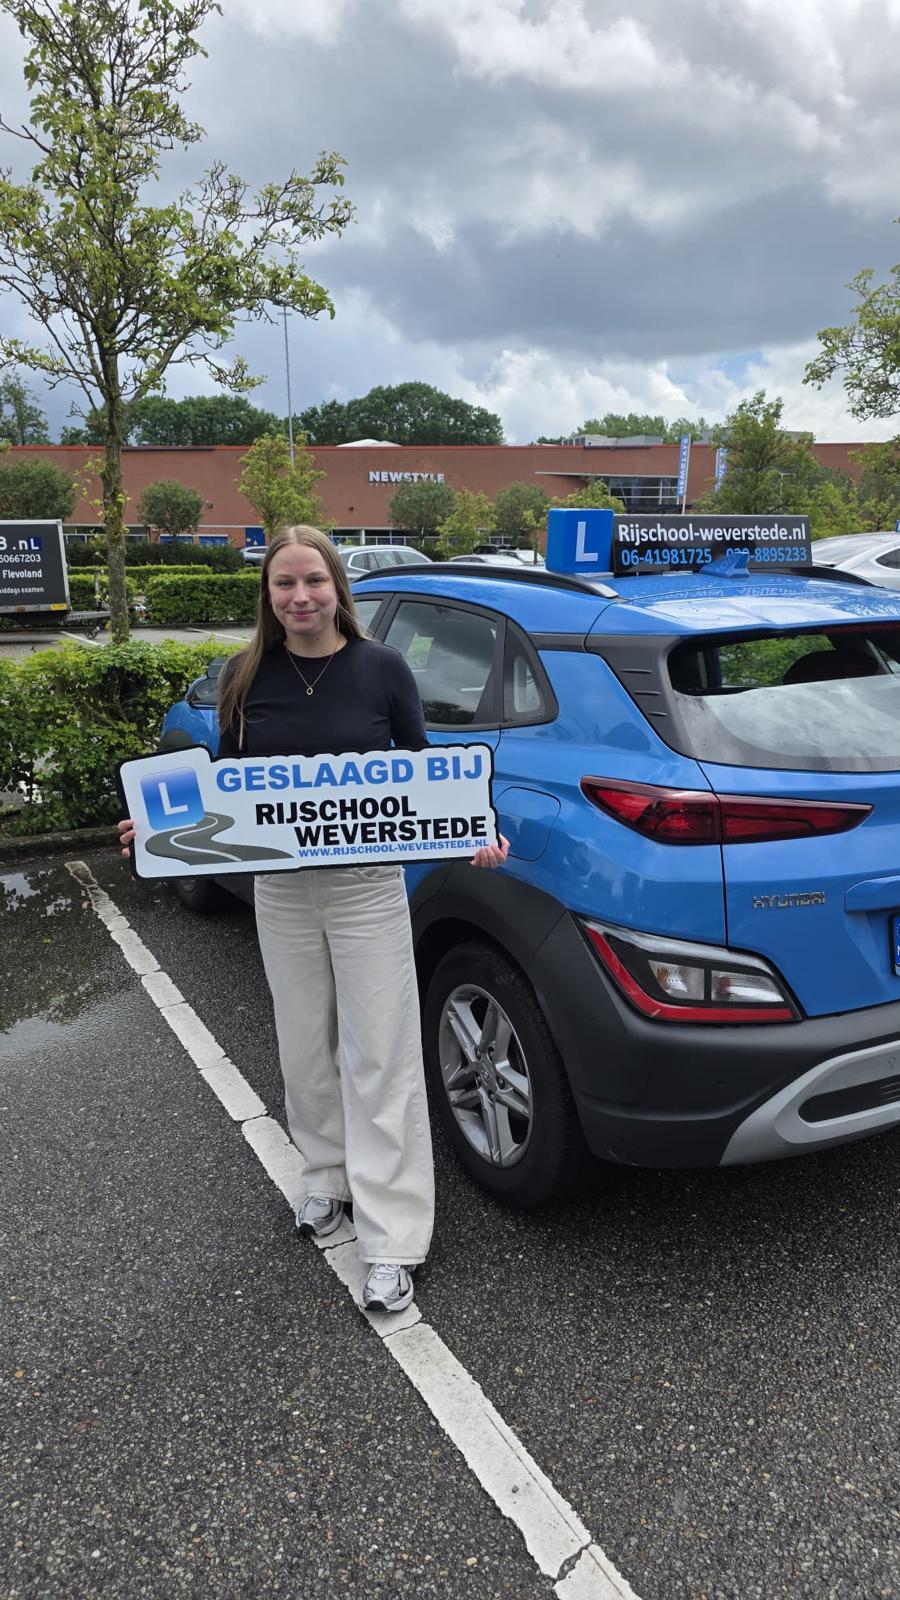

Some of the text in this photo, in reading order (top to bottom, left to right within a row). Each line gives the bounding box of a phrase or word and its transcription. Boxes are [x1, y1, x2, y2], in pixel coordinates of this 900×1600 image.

[369, 471, 445, 485] NEWSTYLE
[575, 521, 599, 563] L
[618, 523, 806, 546] Rijschool-weverstede.nl
[621, 548, 712, 567] 06-41981725
[2, 569, 42, 579] Flevoland
[215, 754, 483, 793] GESLAAGD BIJ
[157, 782, 189, 817] L
[255, 795, 417, 826] RIJSCHOOL
[293, 815, 487, 848] WEVERSTEDE
[298, 839, 490, 859] WWW.RIJSCHOOL-WEVERSTEDE.NL
[752, 891, 826, 909] HYUNDAI
